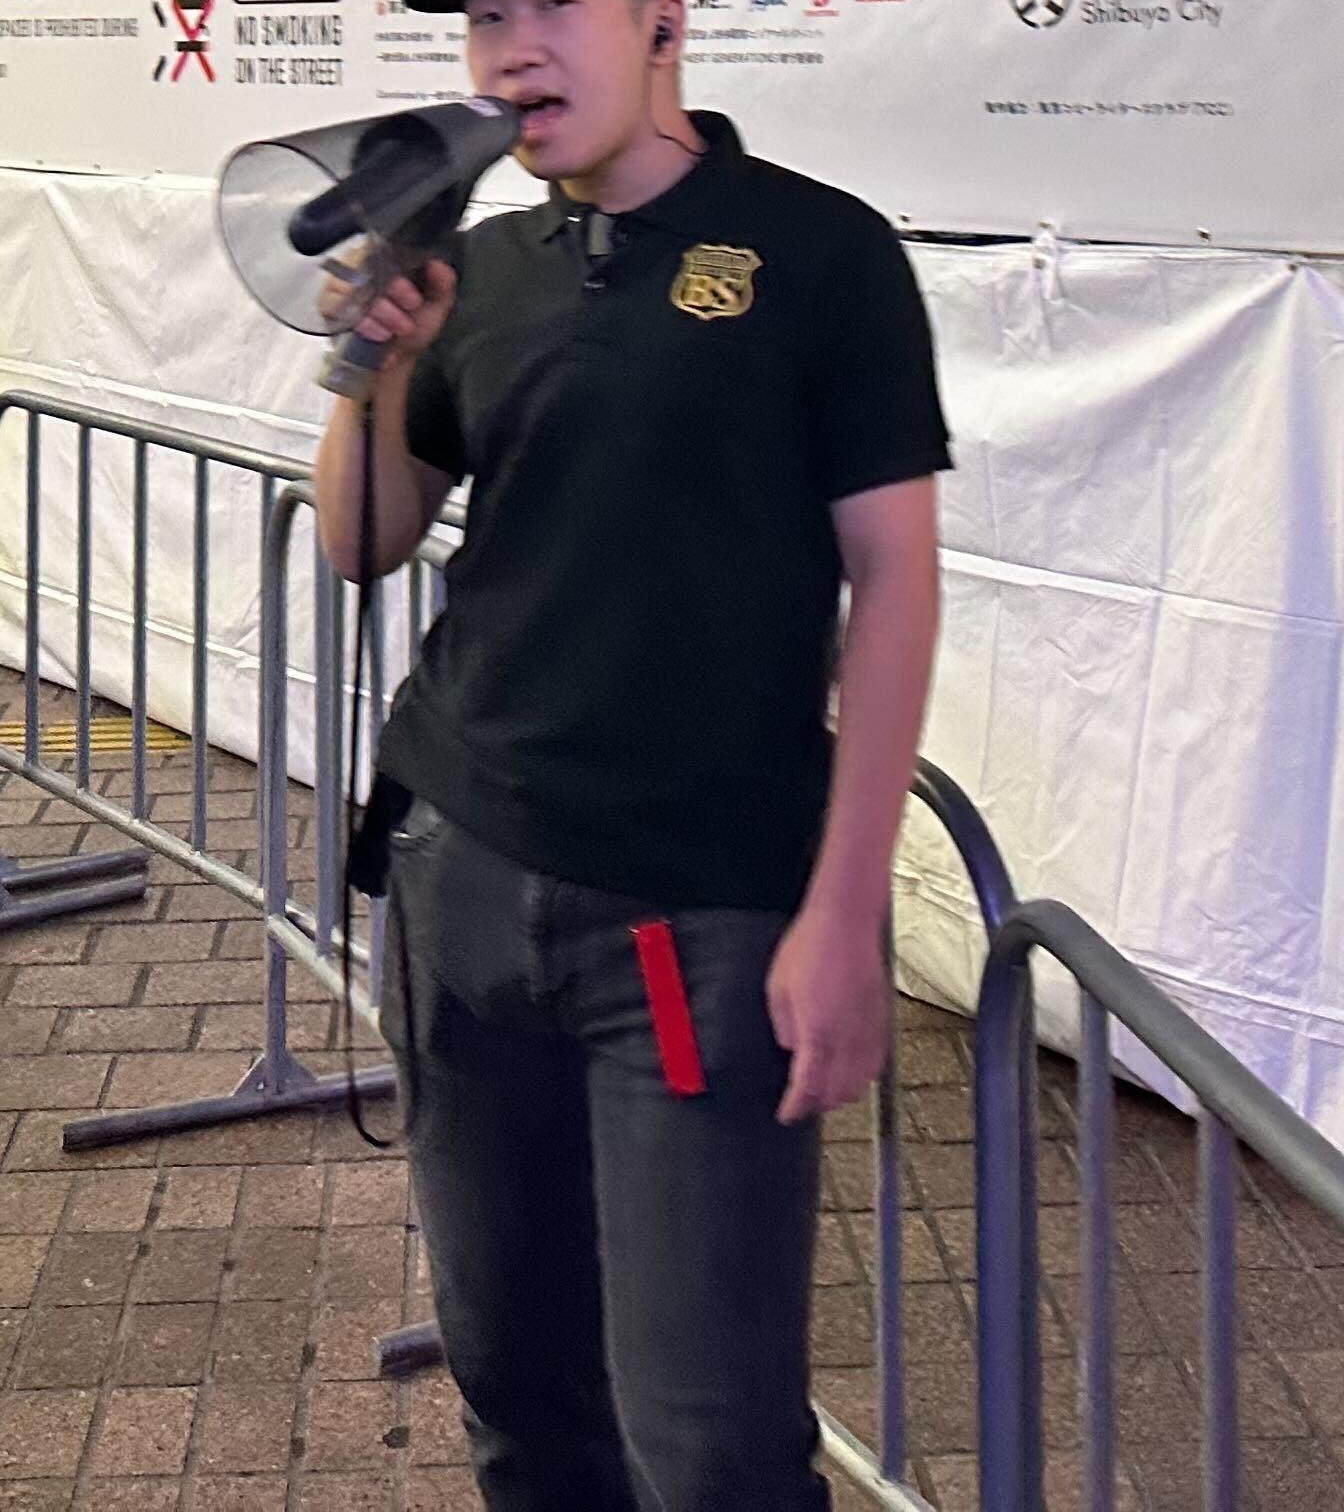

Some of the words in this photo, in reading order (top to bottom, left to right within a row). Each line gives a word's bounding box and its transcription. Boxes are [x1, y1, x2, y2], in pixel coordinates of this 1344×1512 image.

[261, 14, 343, 46] SMOKING
[258, 58, 286, 84] THE
[289, 58, 344, 85] STREET
